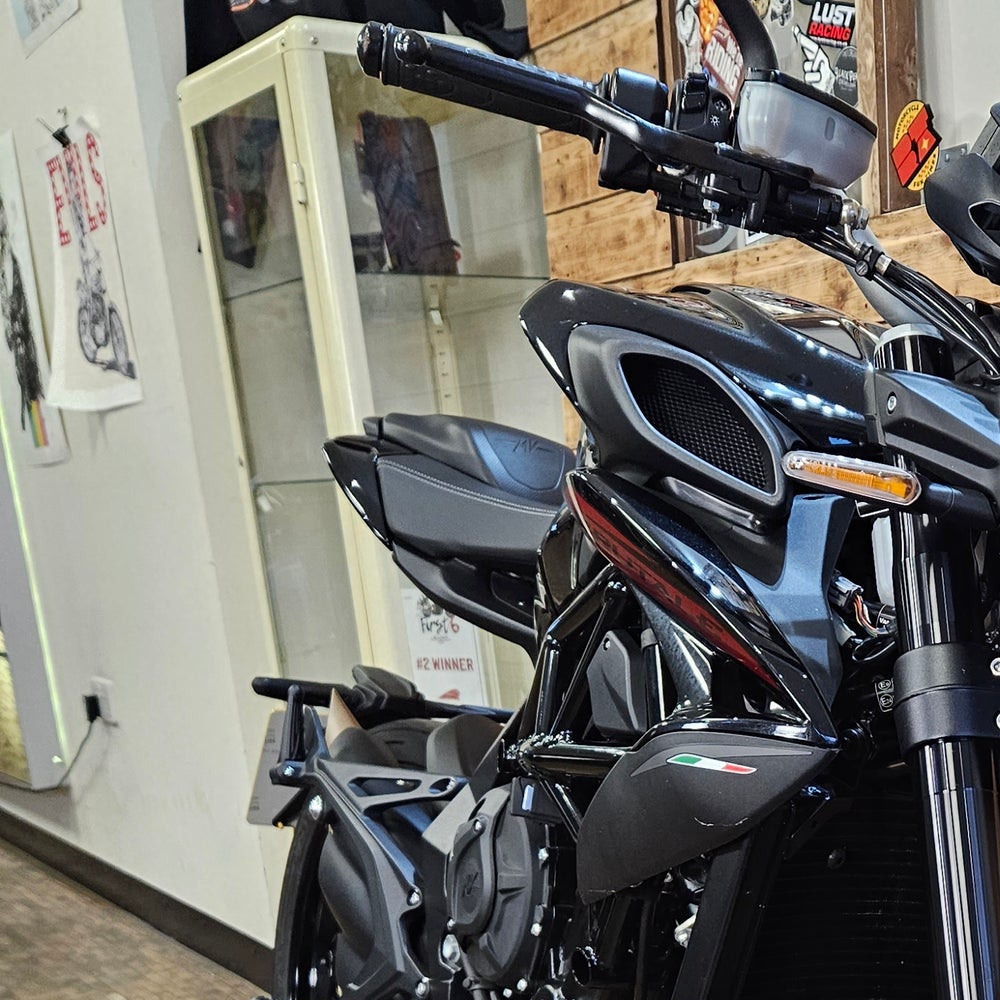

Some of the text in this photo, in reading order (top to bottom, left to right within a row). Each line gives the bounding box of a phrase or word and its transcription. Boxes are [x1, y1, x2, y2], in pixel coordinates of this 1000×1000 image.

[811, 1, 856, 27] LUST
[808, 21, 852, 41] RACING
[704, 35, 742, 93] RIDING
[420, 615, 461, 635] First 6
[416, 657, 474, 672] #2 WINNER
